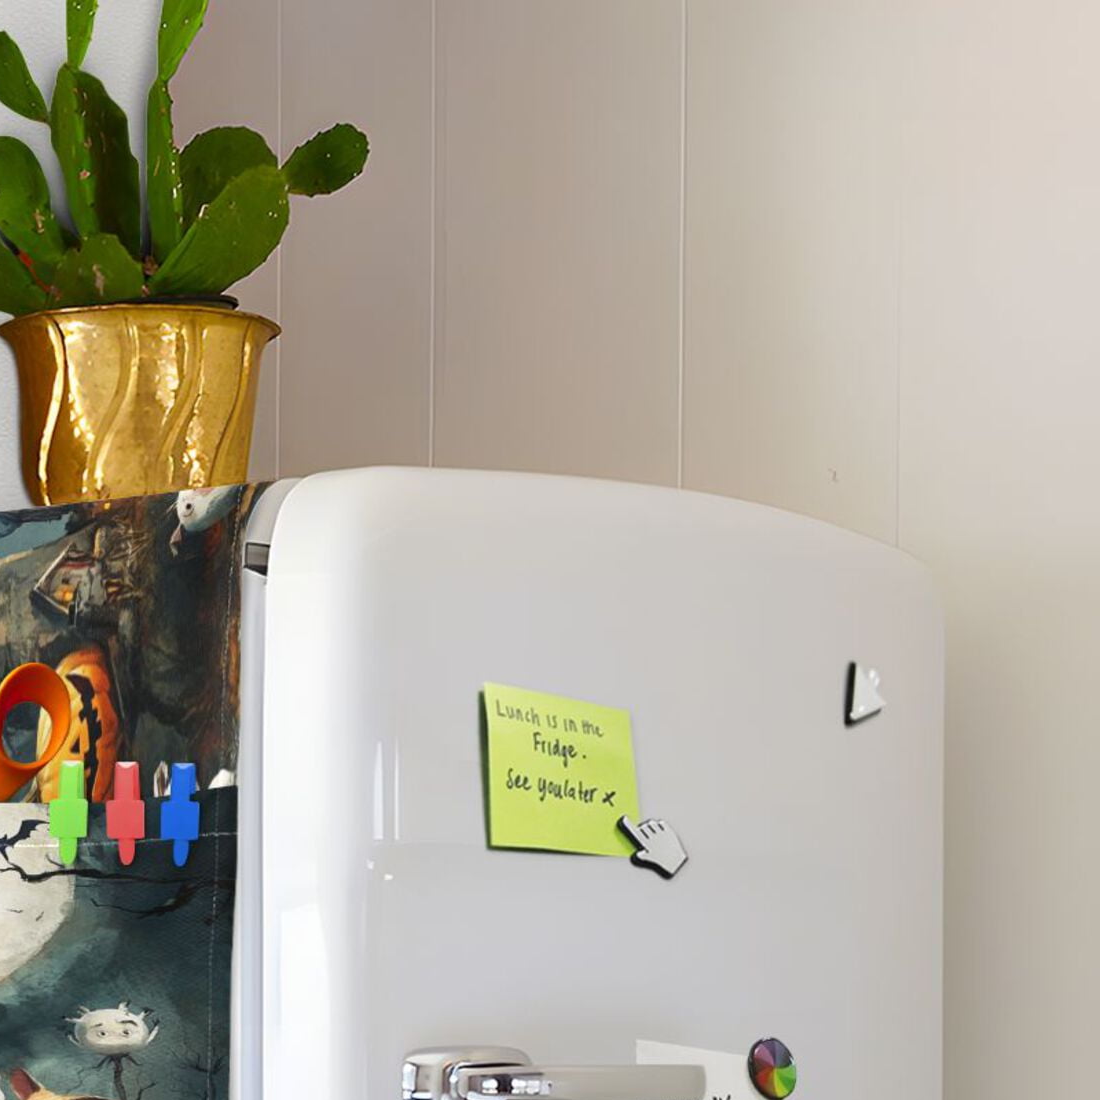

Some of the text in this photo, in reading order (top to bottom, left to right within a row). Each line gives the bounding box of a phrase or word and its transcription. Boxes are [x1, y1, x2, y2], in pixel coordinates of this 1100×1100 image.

[496, 699, 604, 737] Lunch is in the
[506, 768, 532, 791] See
